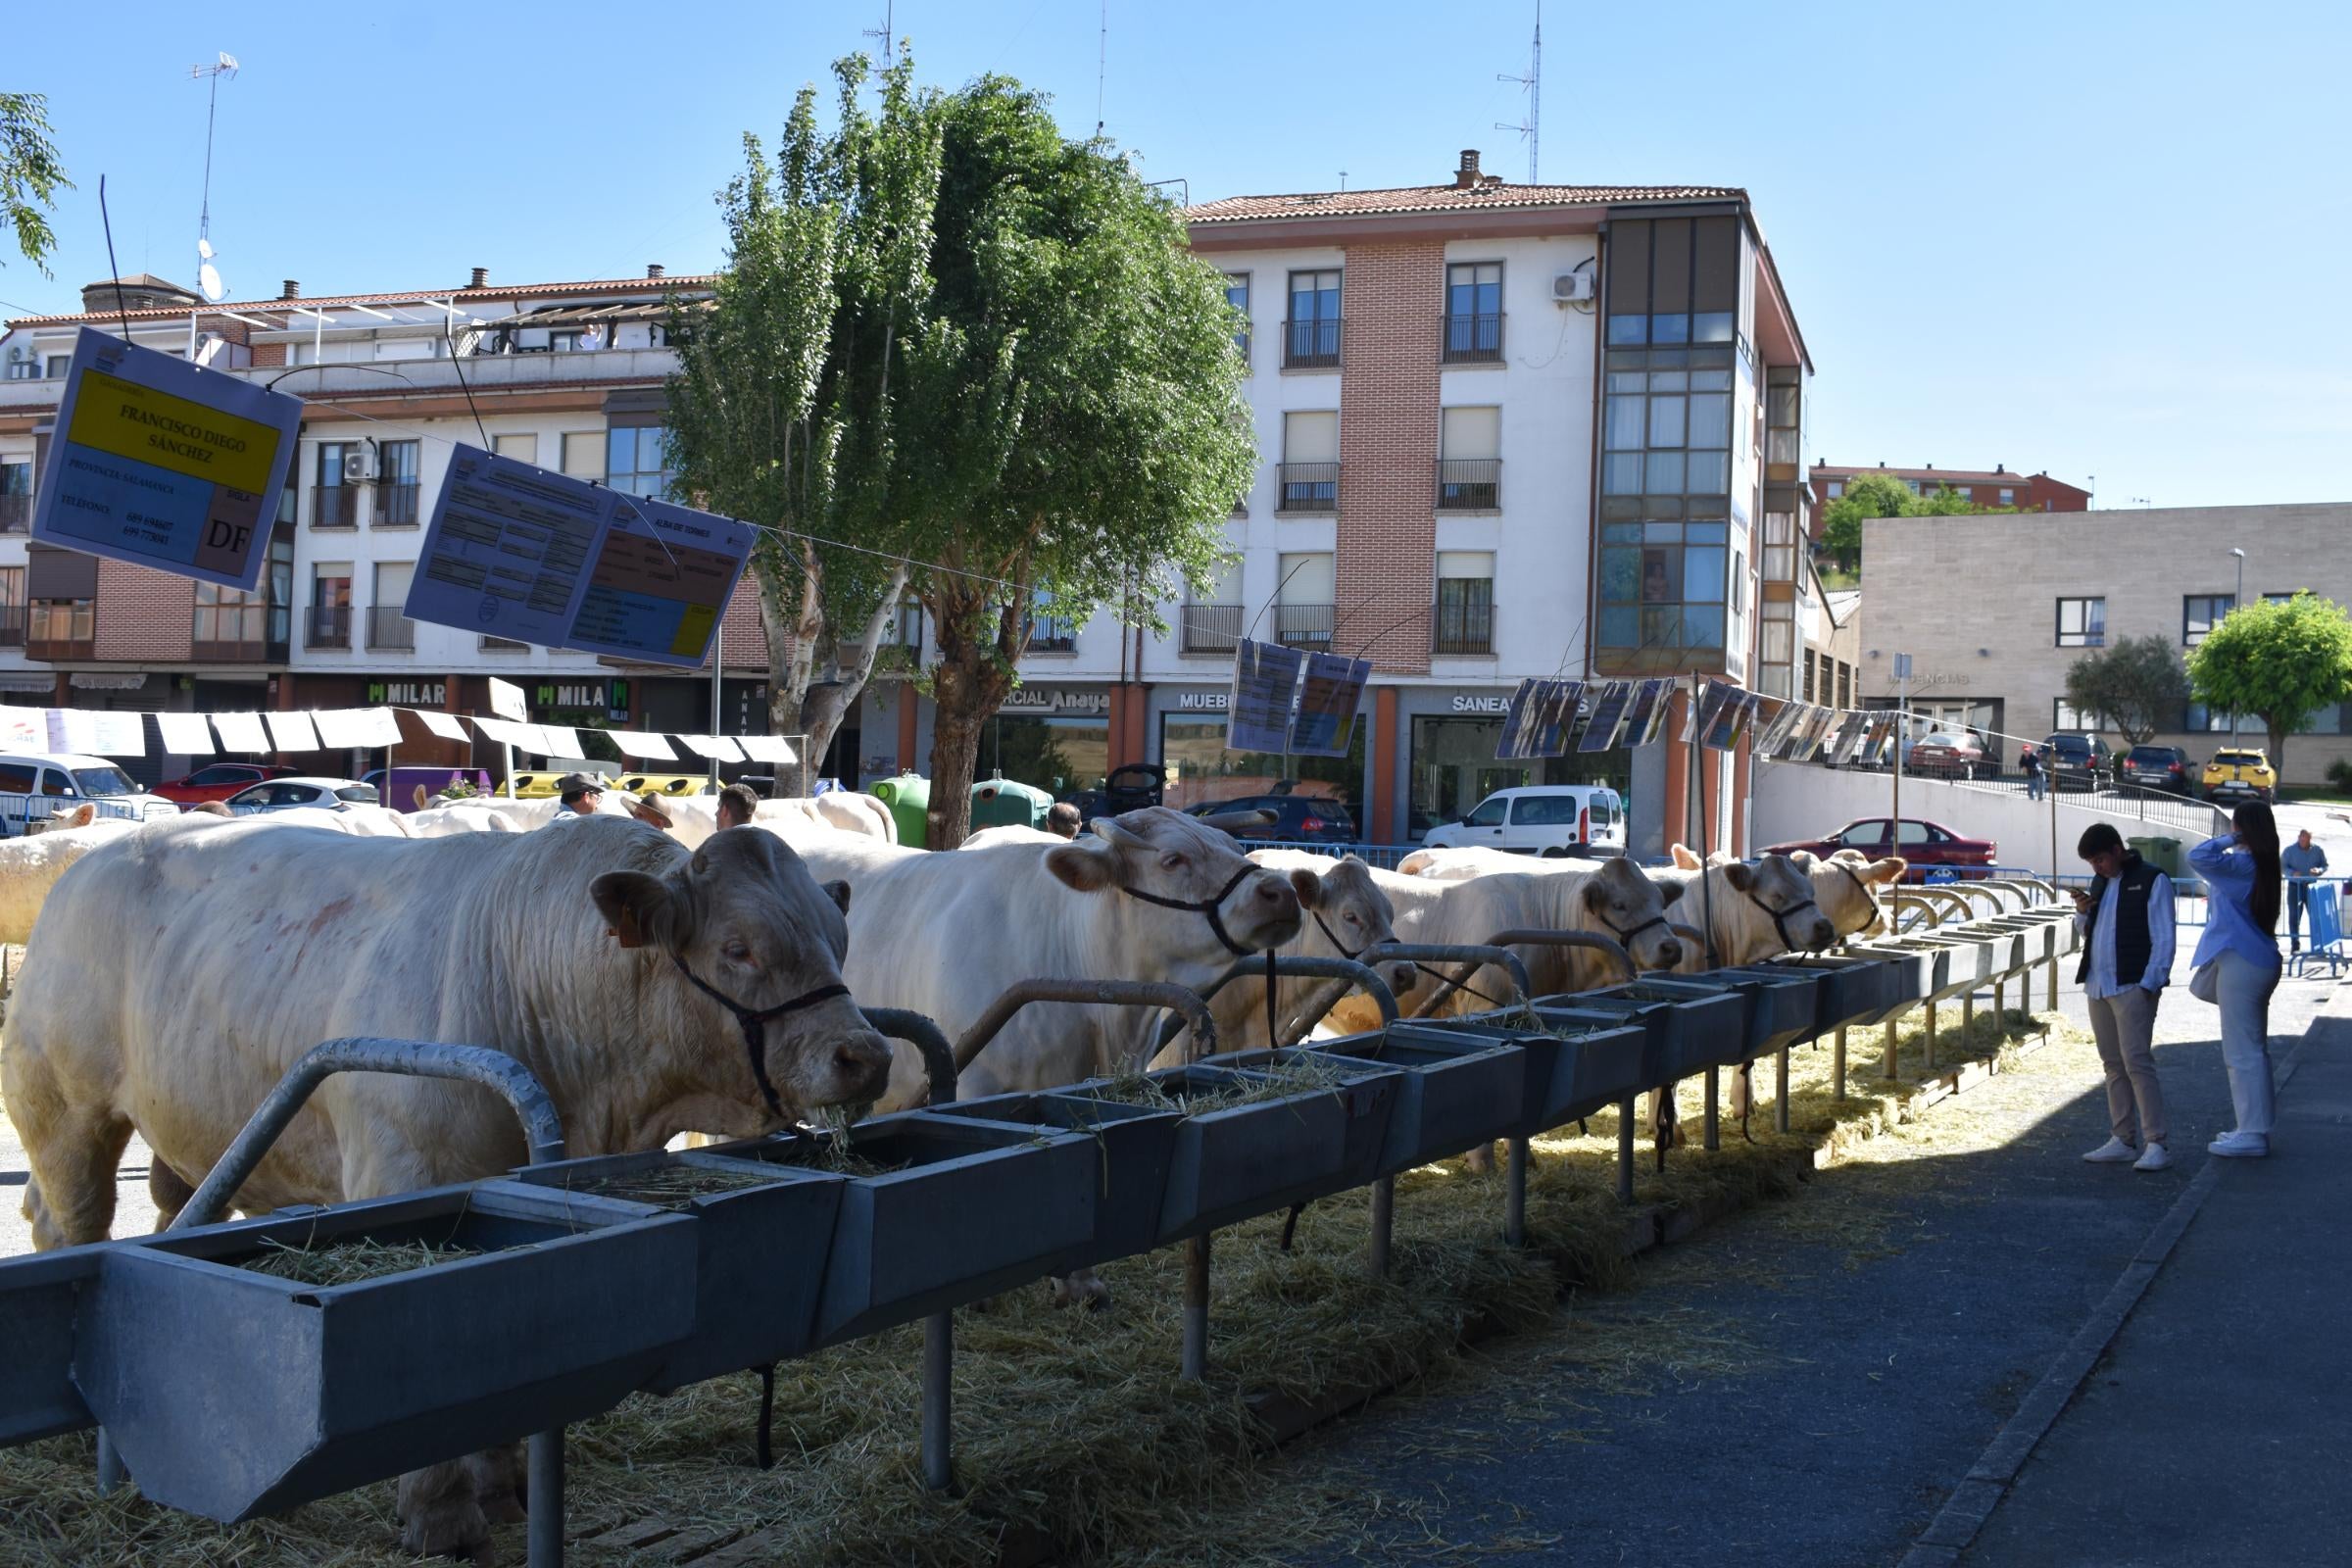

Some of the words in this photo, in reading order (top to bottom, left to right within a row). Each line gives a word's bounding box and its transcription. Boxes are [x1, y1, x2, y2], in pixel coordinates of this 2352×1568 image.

[120, 405, 202, 439] FRANCISCO
[204, 430, 246, 453] DIEGO
[148, 434, 214, 464] SÁNCHEZ
[207, 518, 251, 554] DF
[388, 684, 445, 704] MILAR
[558, 686, 604, 706] MILA
[1052, 690, 1110, 712] Anaya
[740, 690, 749, 736] ANAY
